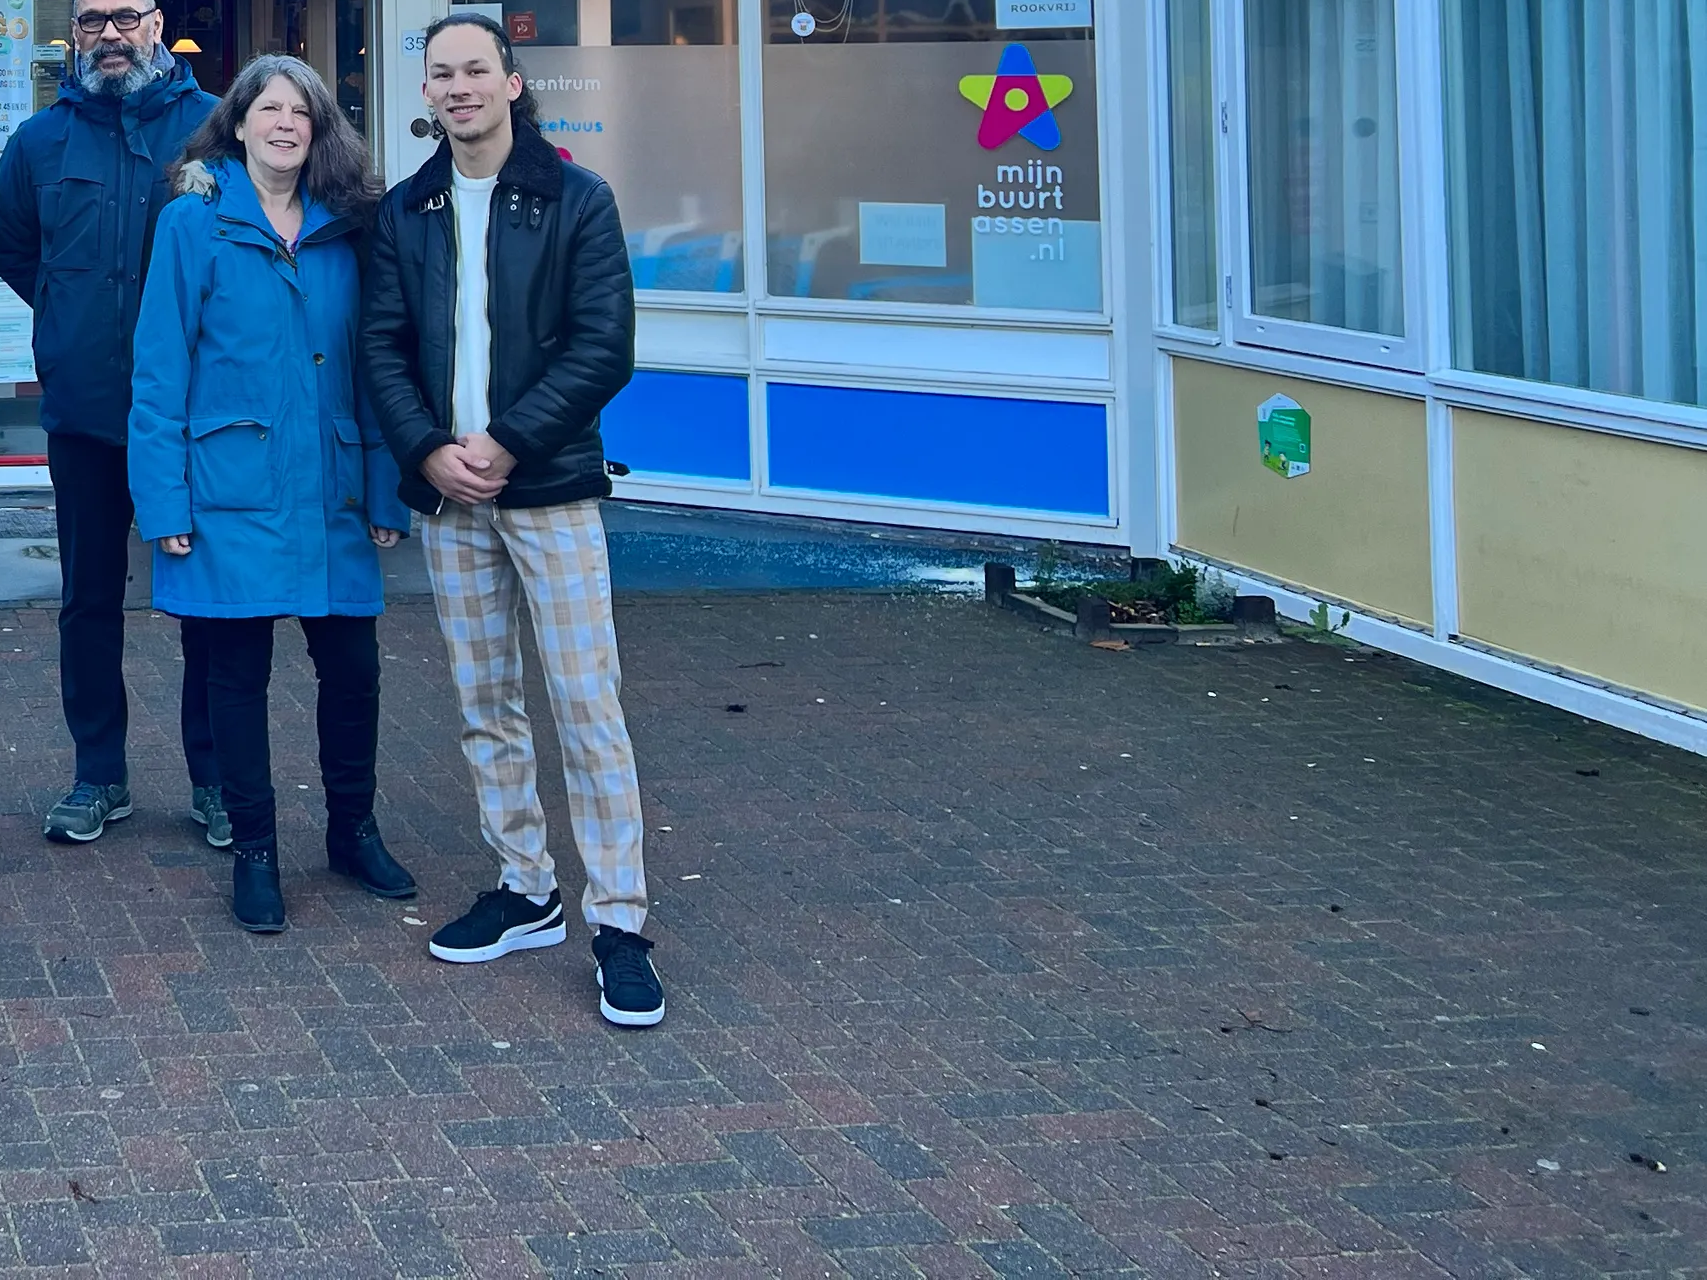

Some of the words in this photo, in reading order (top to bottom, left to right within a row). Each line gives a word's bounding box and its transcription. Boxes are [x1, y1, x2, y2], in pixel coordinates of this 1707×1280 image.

[1010, 3, 1076, 13] ROOKVRIJ
[405, 37, 426, 50] 35
[526, 74, 601, 91] centrum
[997, 159, 1063, 189] mijn
[977, 184, 1063, 210] buurt
[974, 215, 1063, 235] assen
[1030, 237, 1064, 261] .nl
